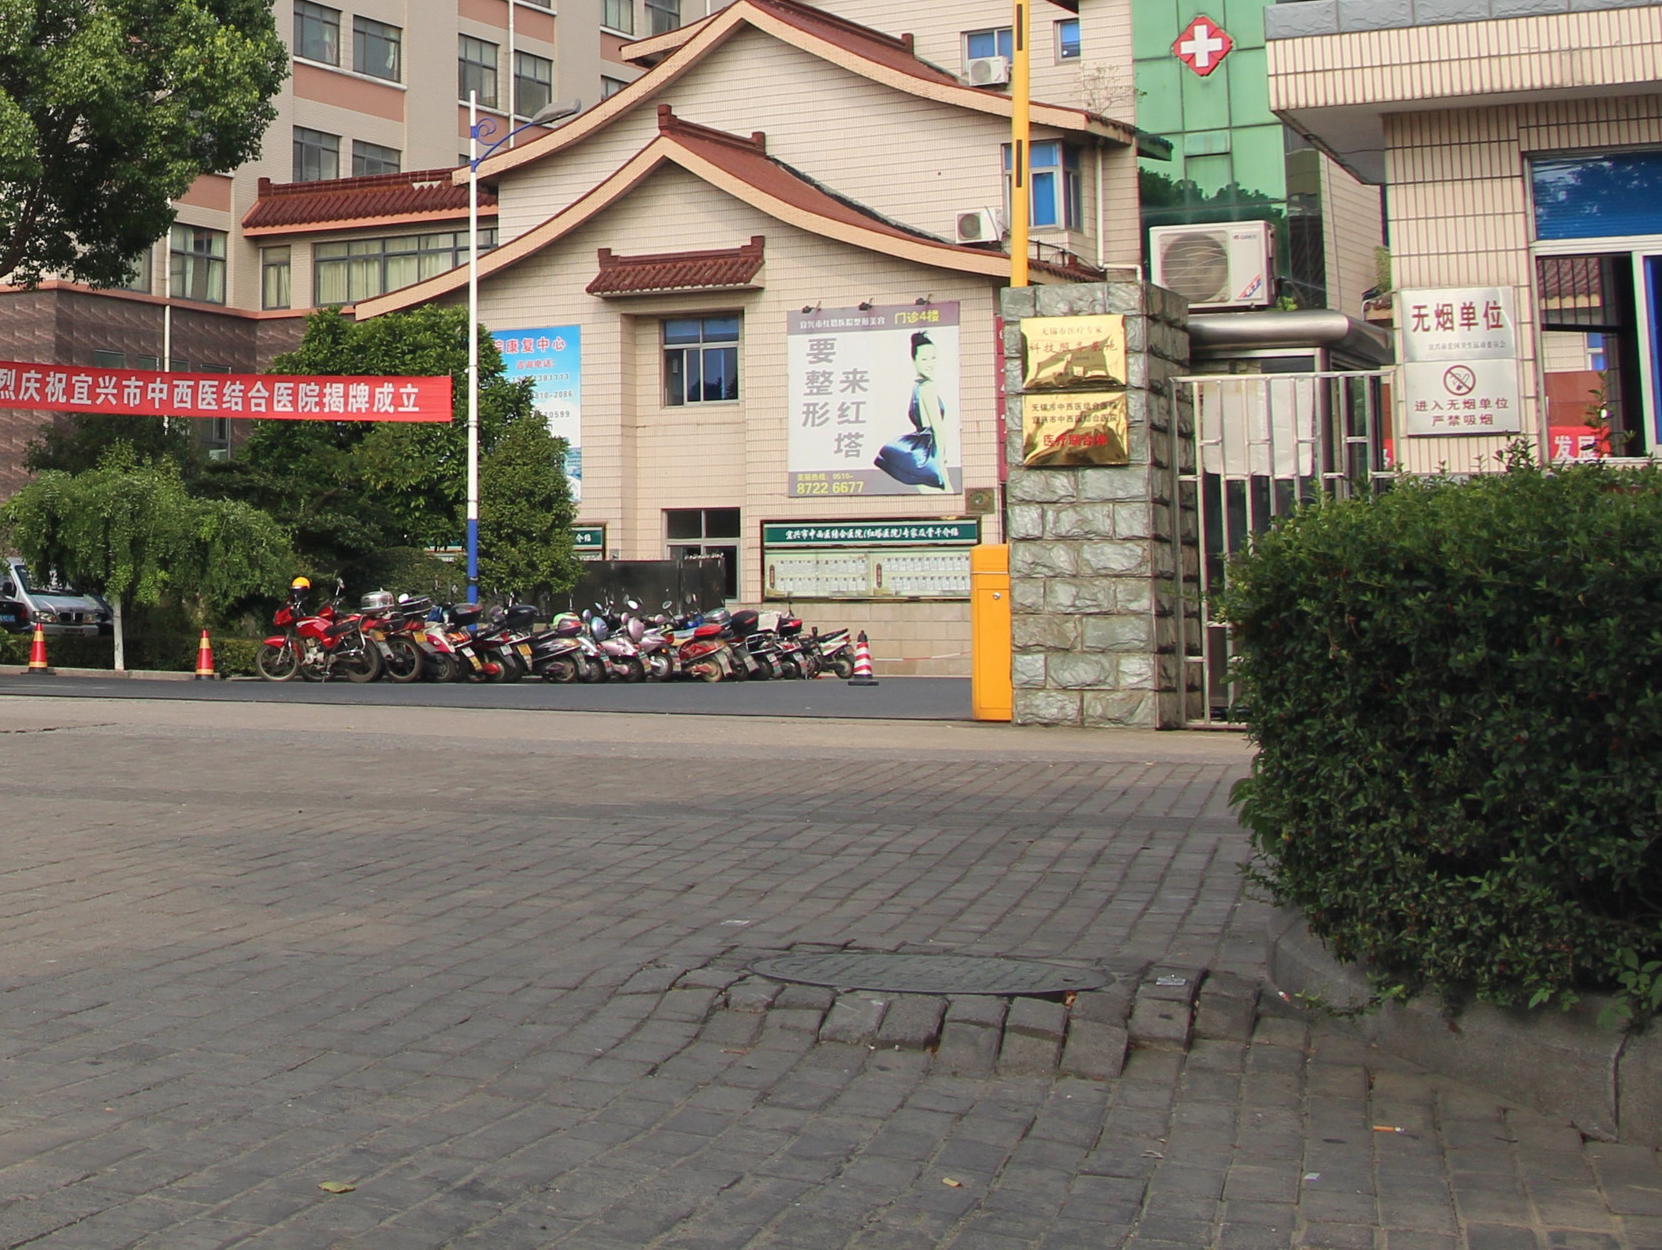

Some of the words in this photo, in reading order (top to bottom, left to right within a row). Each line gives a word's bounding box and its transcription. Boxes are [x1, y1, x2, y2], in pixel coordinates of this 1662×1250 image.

[894, 309, 940, 325] 门诊4楼
[1411, 300, 1504, 333] 无烟单位
[512, 372, 570, 384] 11381111
[801, 337, 838, 428] 要整形
[1414, 397, 1509, 412] 进入无烟单位
[833, 368, 870, 459] 来红塔
[1432, 414, 1494, 427] 严禁吸烟
[796, 482, 829, 495] 8722
[832, 481, 864, 494] 6677
